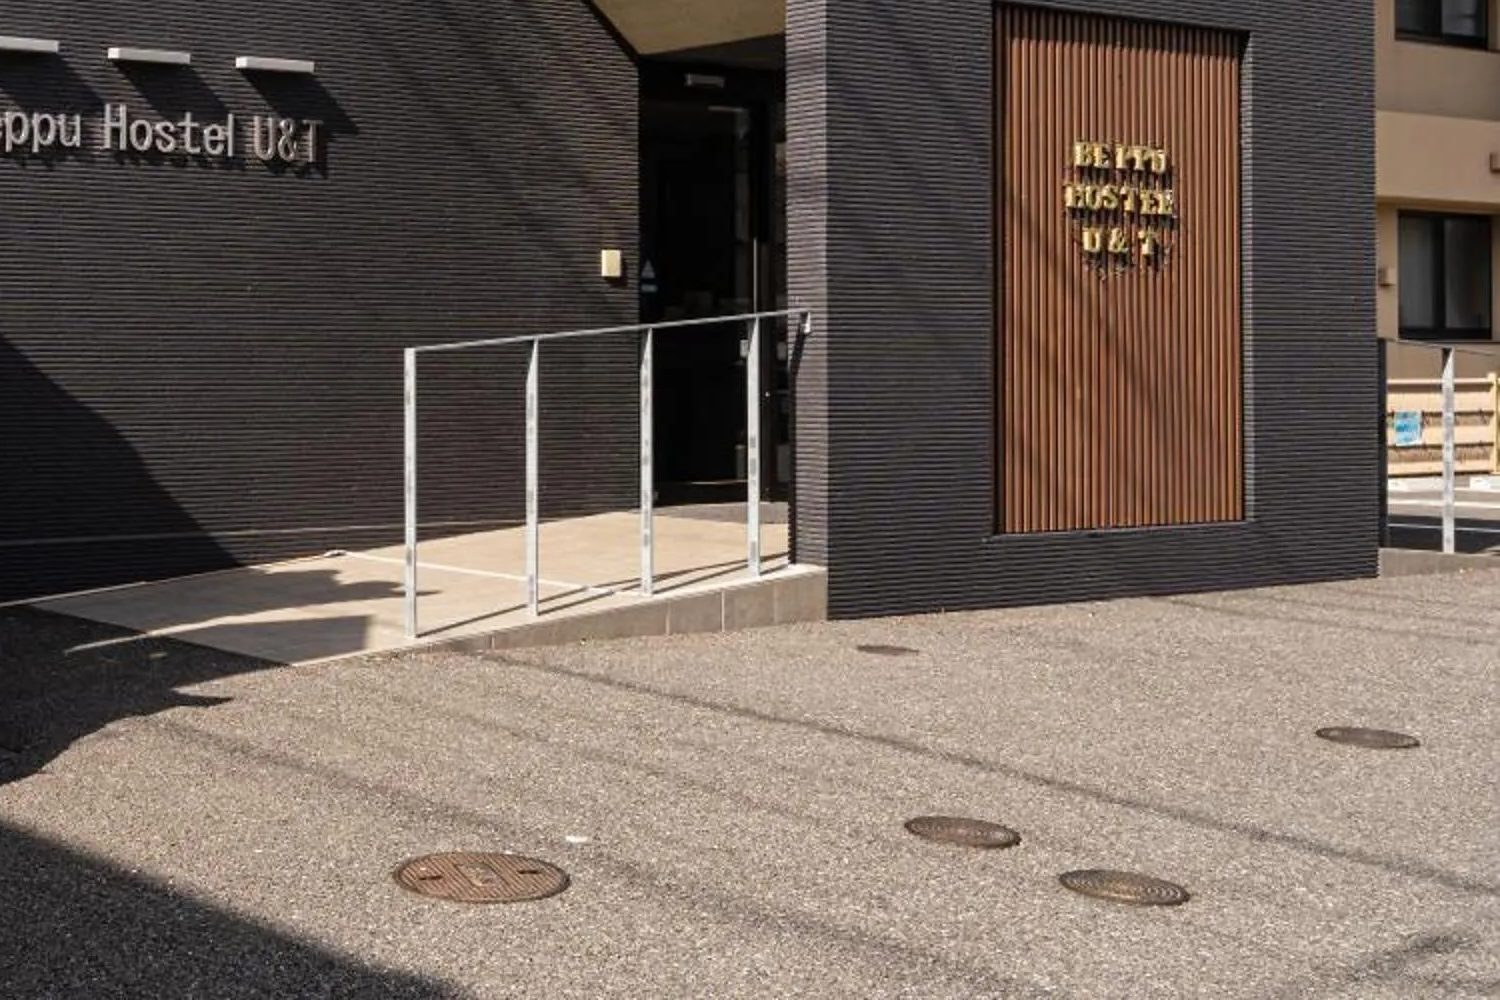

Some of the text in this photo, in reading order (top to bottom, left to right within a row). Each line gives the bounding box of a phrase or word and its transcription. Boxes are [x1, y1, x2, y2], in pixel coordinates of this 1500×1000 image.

[104, 103, 235, 158] Hostel
[253, 114, 324, 163] U&T
[1074, 142, 1167, 173] BEPPU
